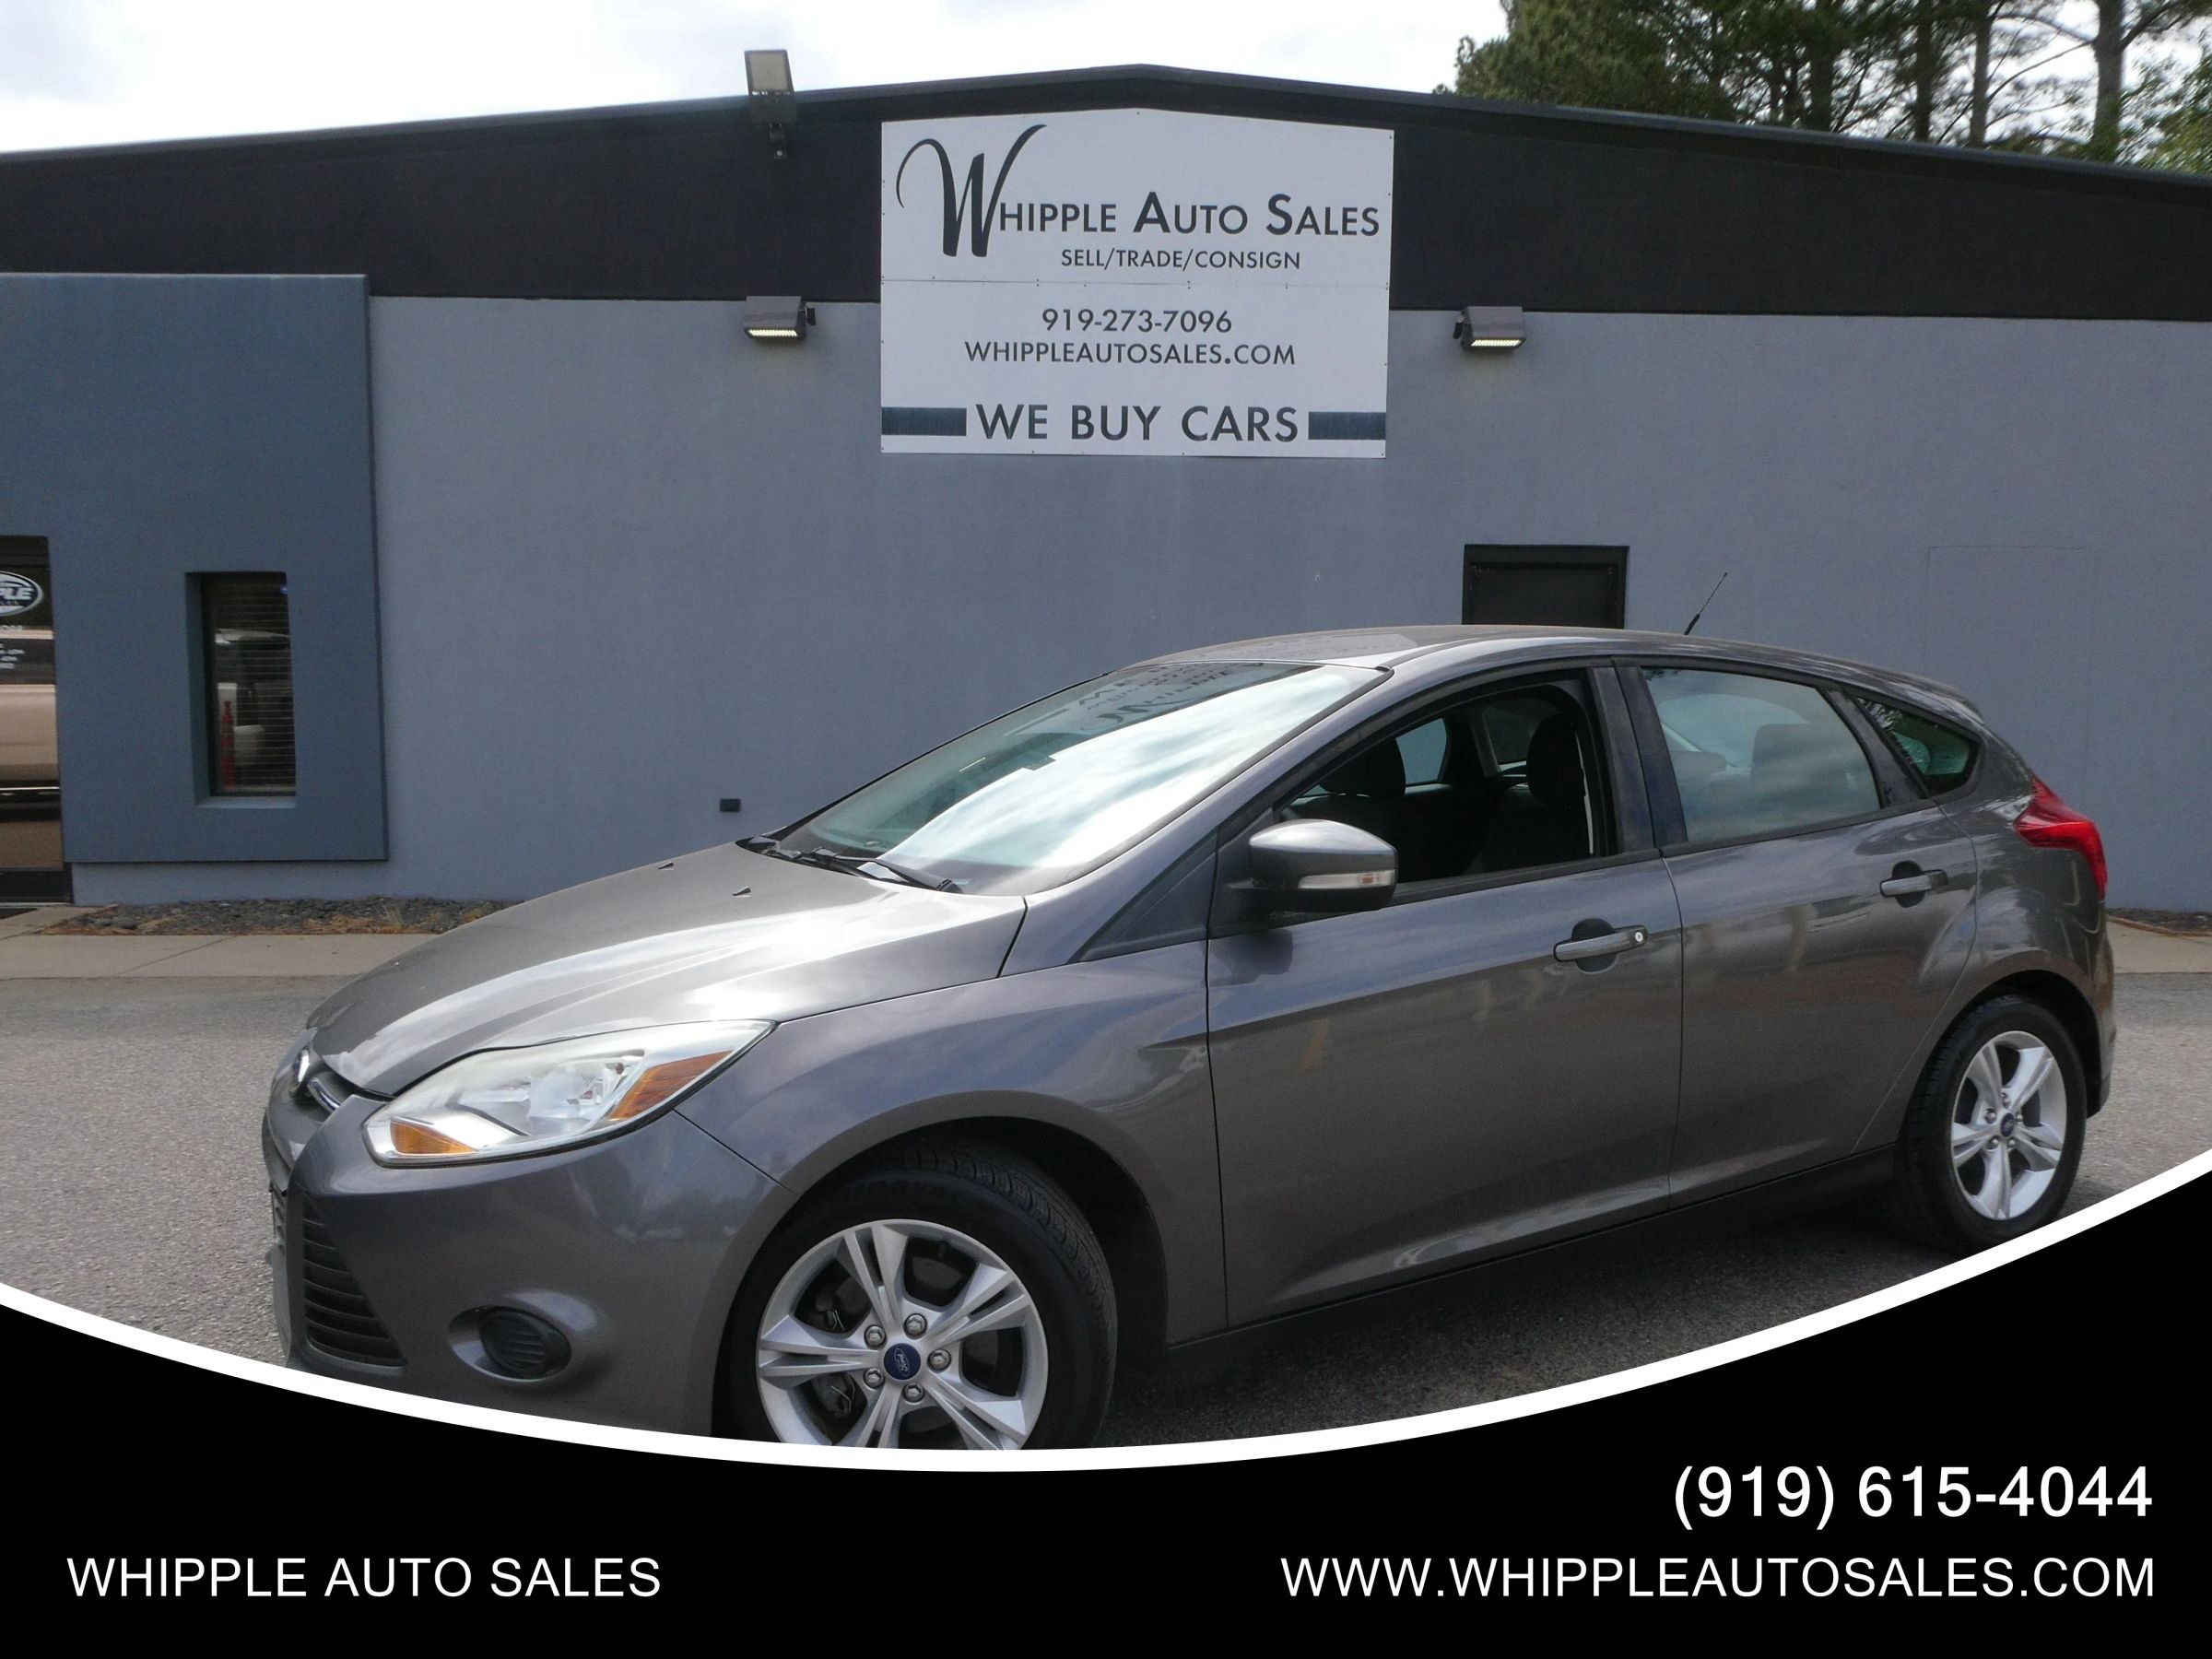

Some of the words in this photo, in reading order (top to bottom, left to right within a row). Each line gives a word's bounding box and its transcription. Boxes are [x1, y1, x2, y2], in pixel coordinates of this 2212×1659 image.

[895, 124, 1117, 258] WHIPPLE
[1133, 191, 1248, 235] AUTO
[1265, 193, 1380, 237] SALES
[1061, 247, 1300, 272] SELL/TRADE/CONSIGN
[1041, 308, 1232, 334] 919-273-7096
[964, 341, 1295, 365] WHIPPLEAUTOSALES.COM
[975, 404, 1048, 441] WE
[1071, 405, 1161, 441] BUY
[1181, 405, 1299, 443] CARS
